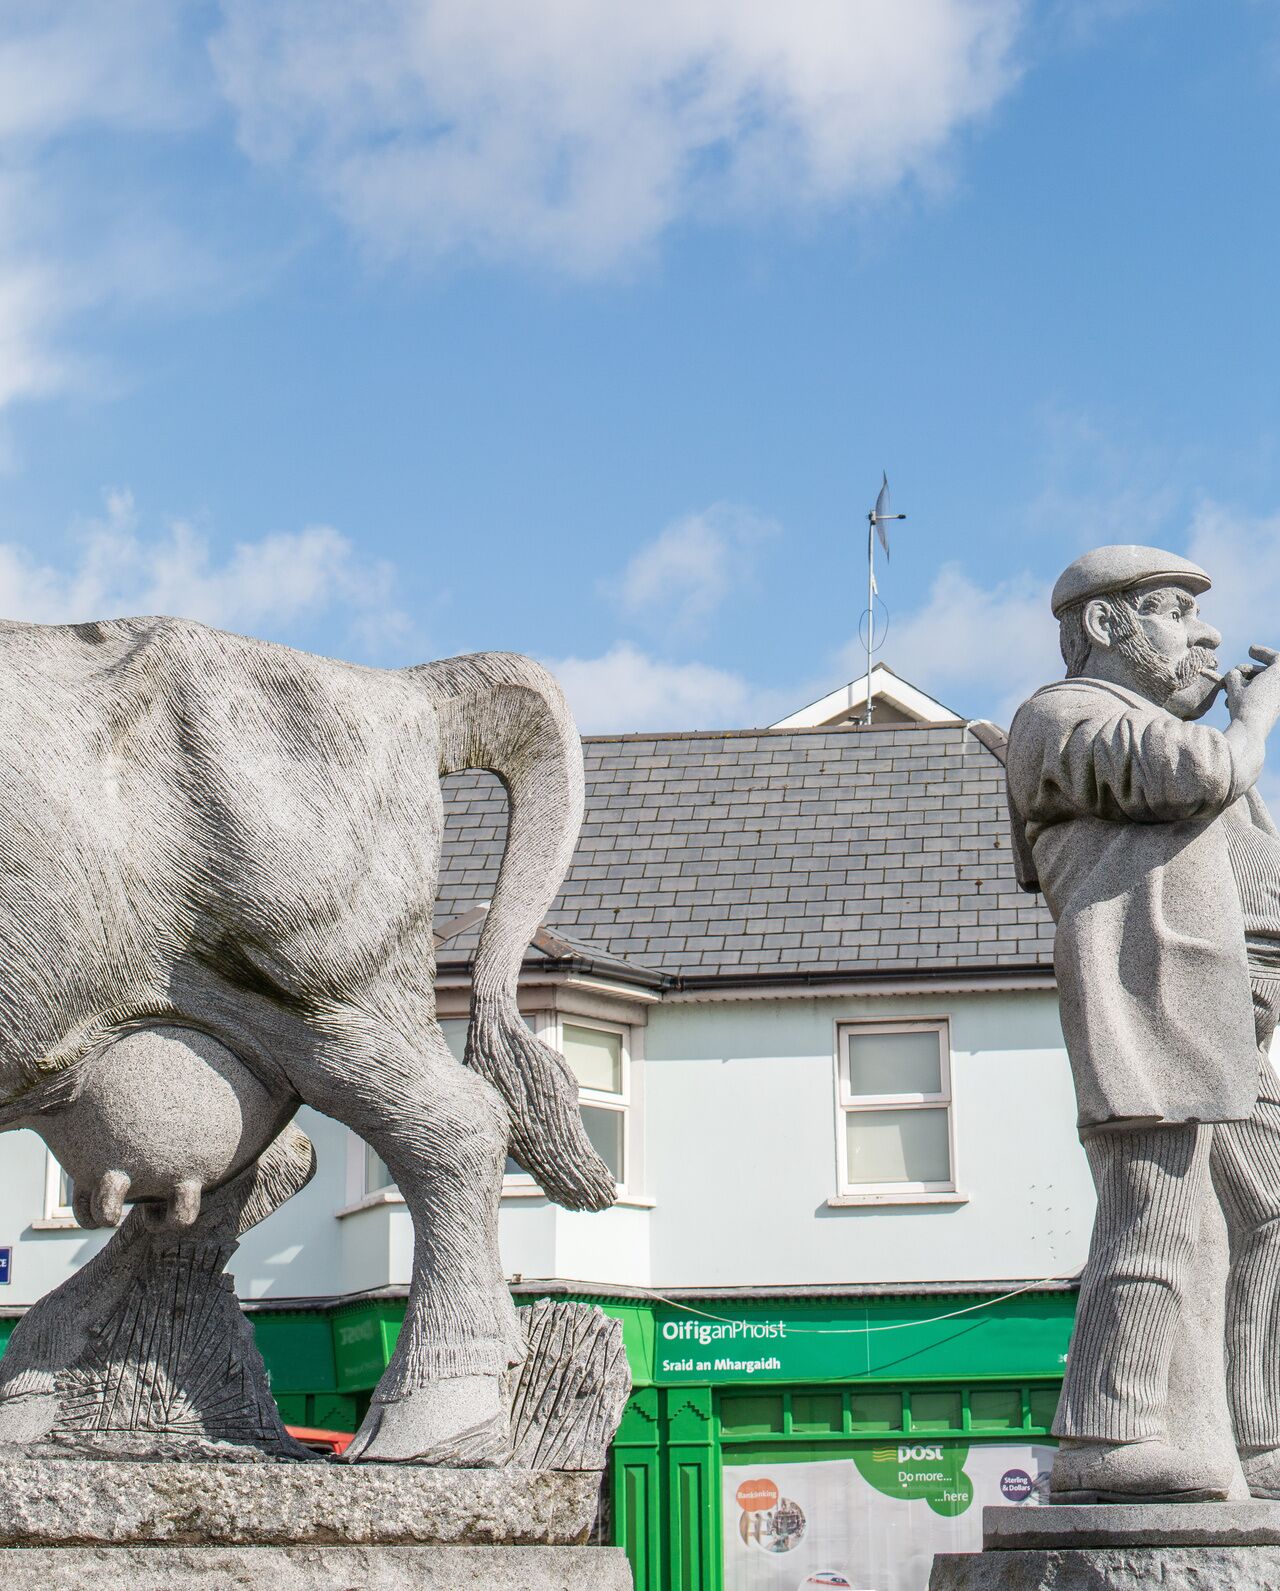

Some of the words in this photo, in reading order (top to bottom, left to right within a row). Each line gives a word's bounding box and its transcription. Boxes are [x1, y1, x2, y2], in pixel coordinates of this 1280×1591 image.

[662, 1359, 693, 1371] Sraid
[696, 1361, 711, 1371] an
[714, 1357, 781, 1373] Mhargaidh
[897, 1445, 944, 1463] post
[898, 1471, 914, 1482] Do
[916, 1472, 952, 1482] more...
[1004, 1477, 1028, 1485] Sterling
[934, 1490, 969, 1502] ...here
